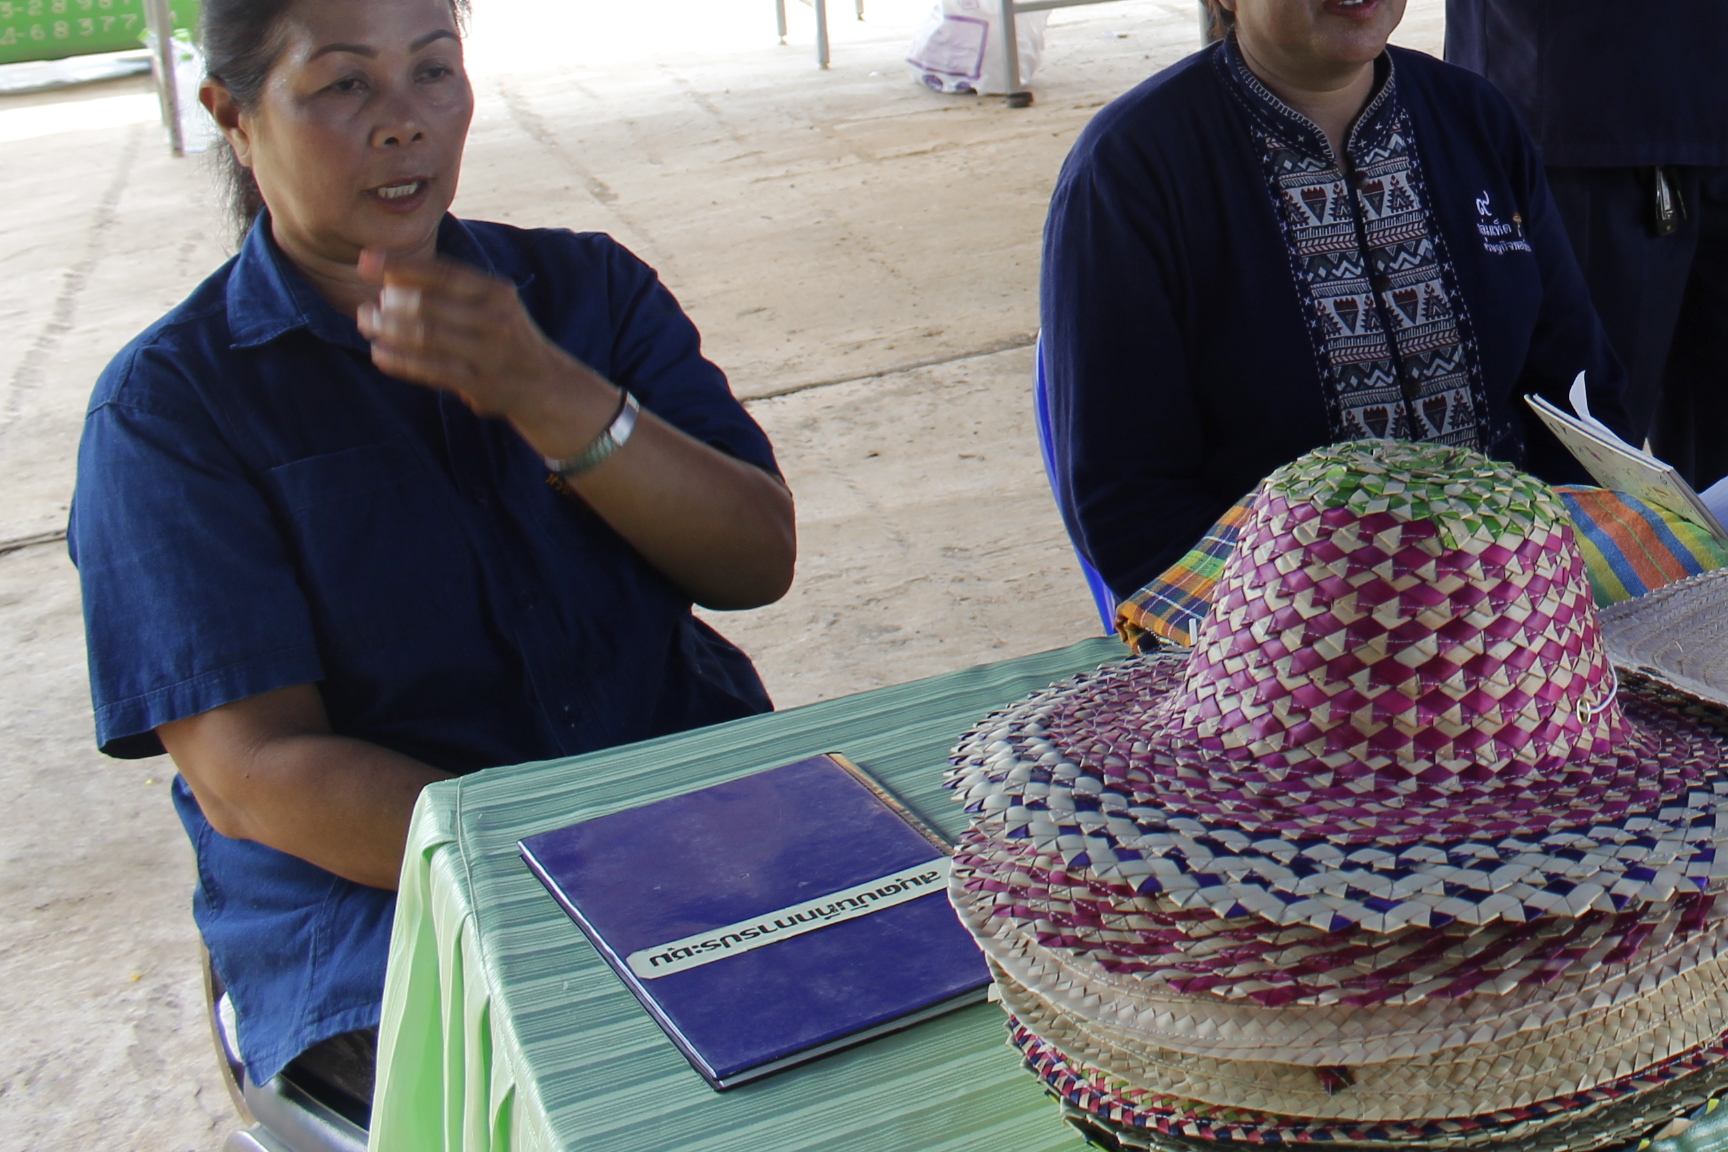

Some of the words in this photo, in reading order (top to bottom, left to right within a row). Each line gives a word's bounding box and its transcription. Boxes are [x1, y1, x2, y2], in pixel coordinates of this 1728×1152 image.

[0, 10, 179, 47] 4-683771
[647, 869, 942, 968] สมุดบันทึกการประชุม
